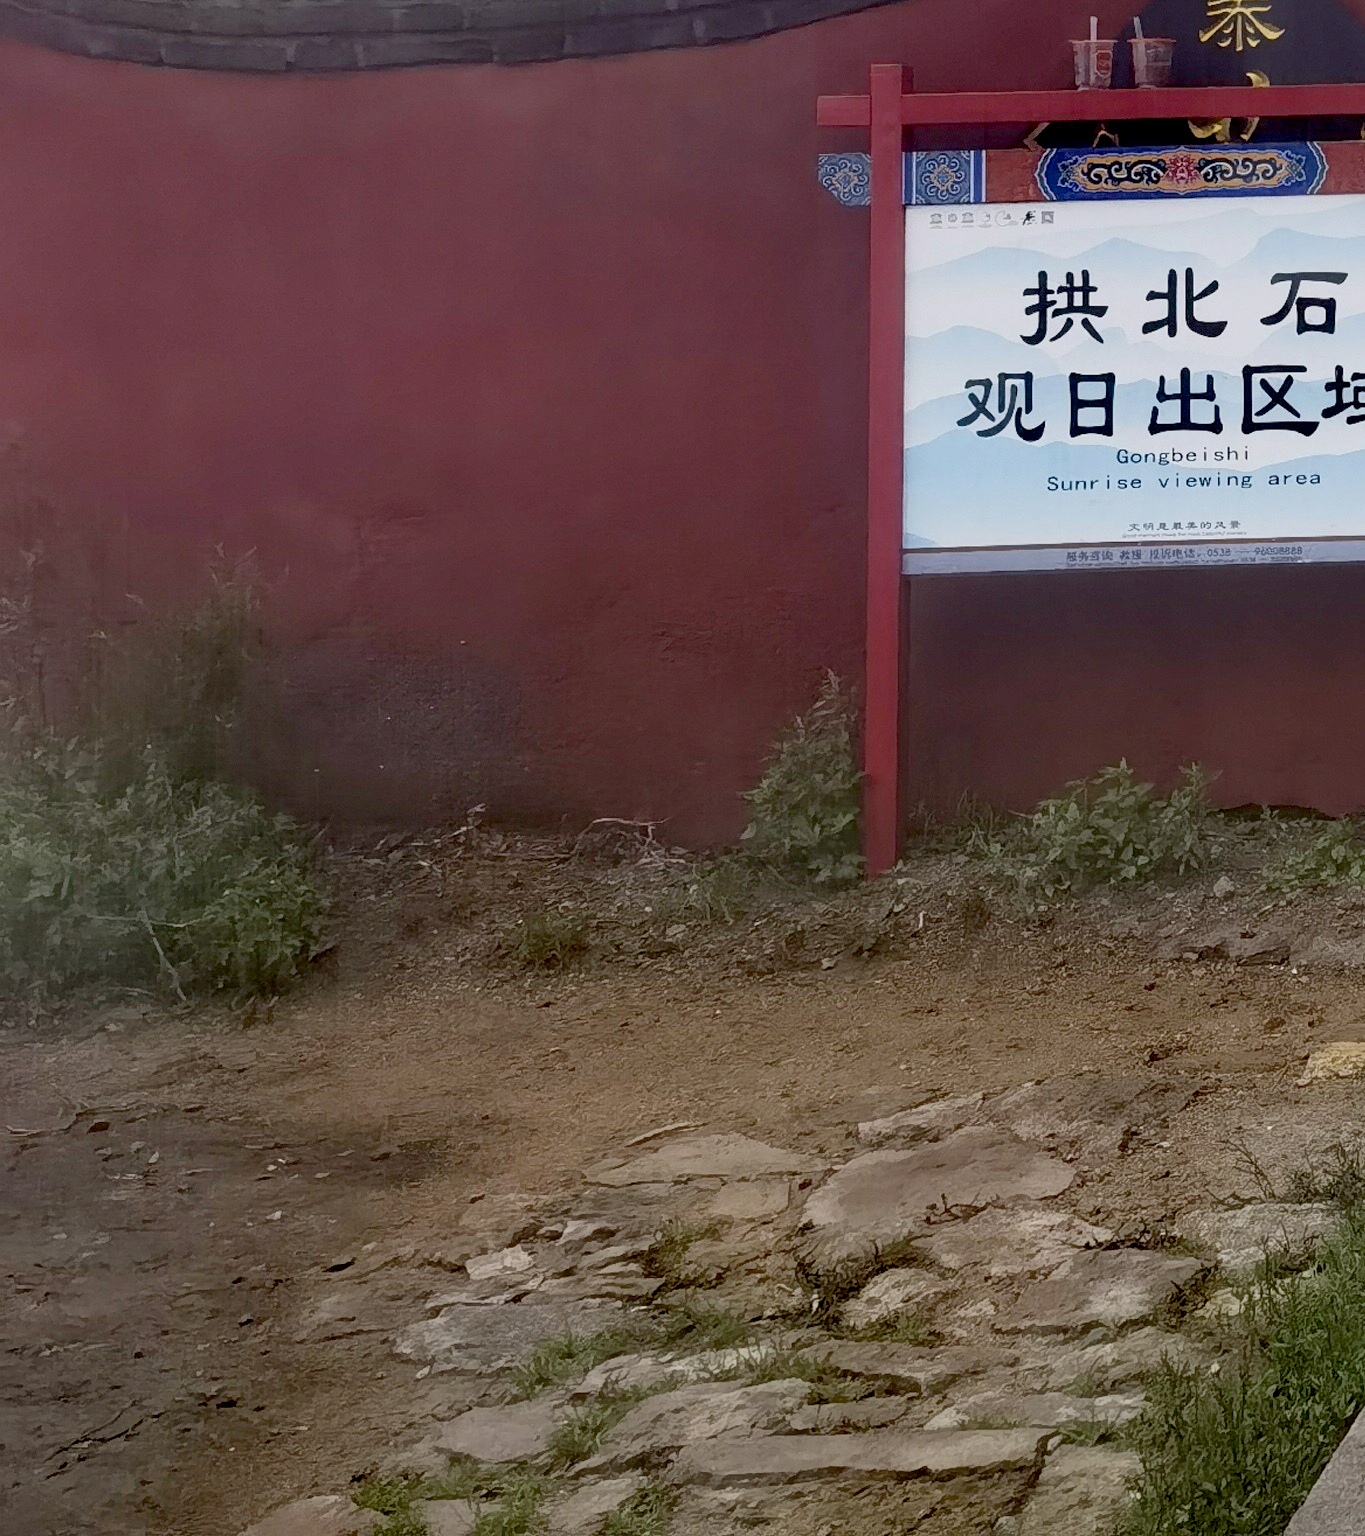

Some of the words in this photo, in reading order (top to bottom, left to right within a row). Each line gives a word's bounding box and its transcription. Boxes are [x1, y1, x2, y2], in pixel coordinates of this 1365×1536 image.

[1019, 267, 1350, 345] 拱北石
[1116, 446, 1250, 466] Gongbeishi
[1046, 475, 1142, 491] Sunrise
[1158, 472, 1253, 489] viewing
[1268, 473, 1322, 486] area
